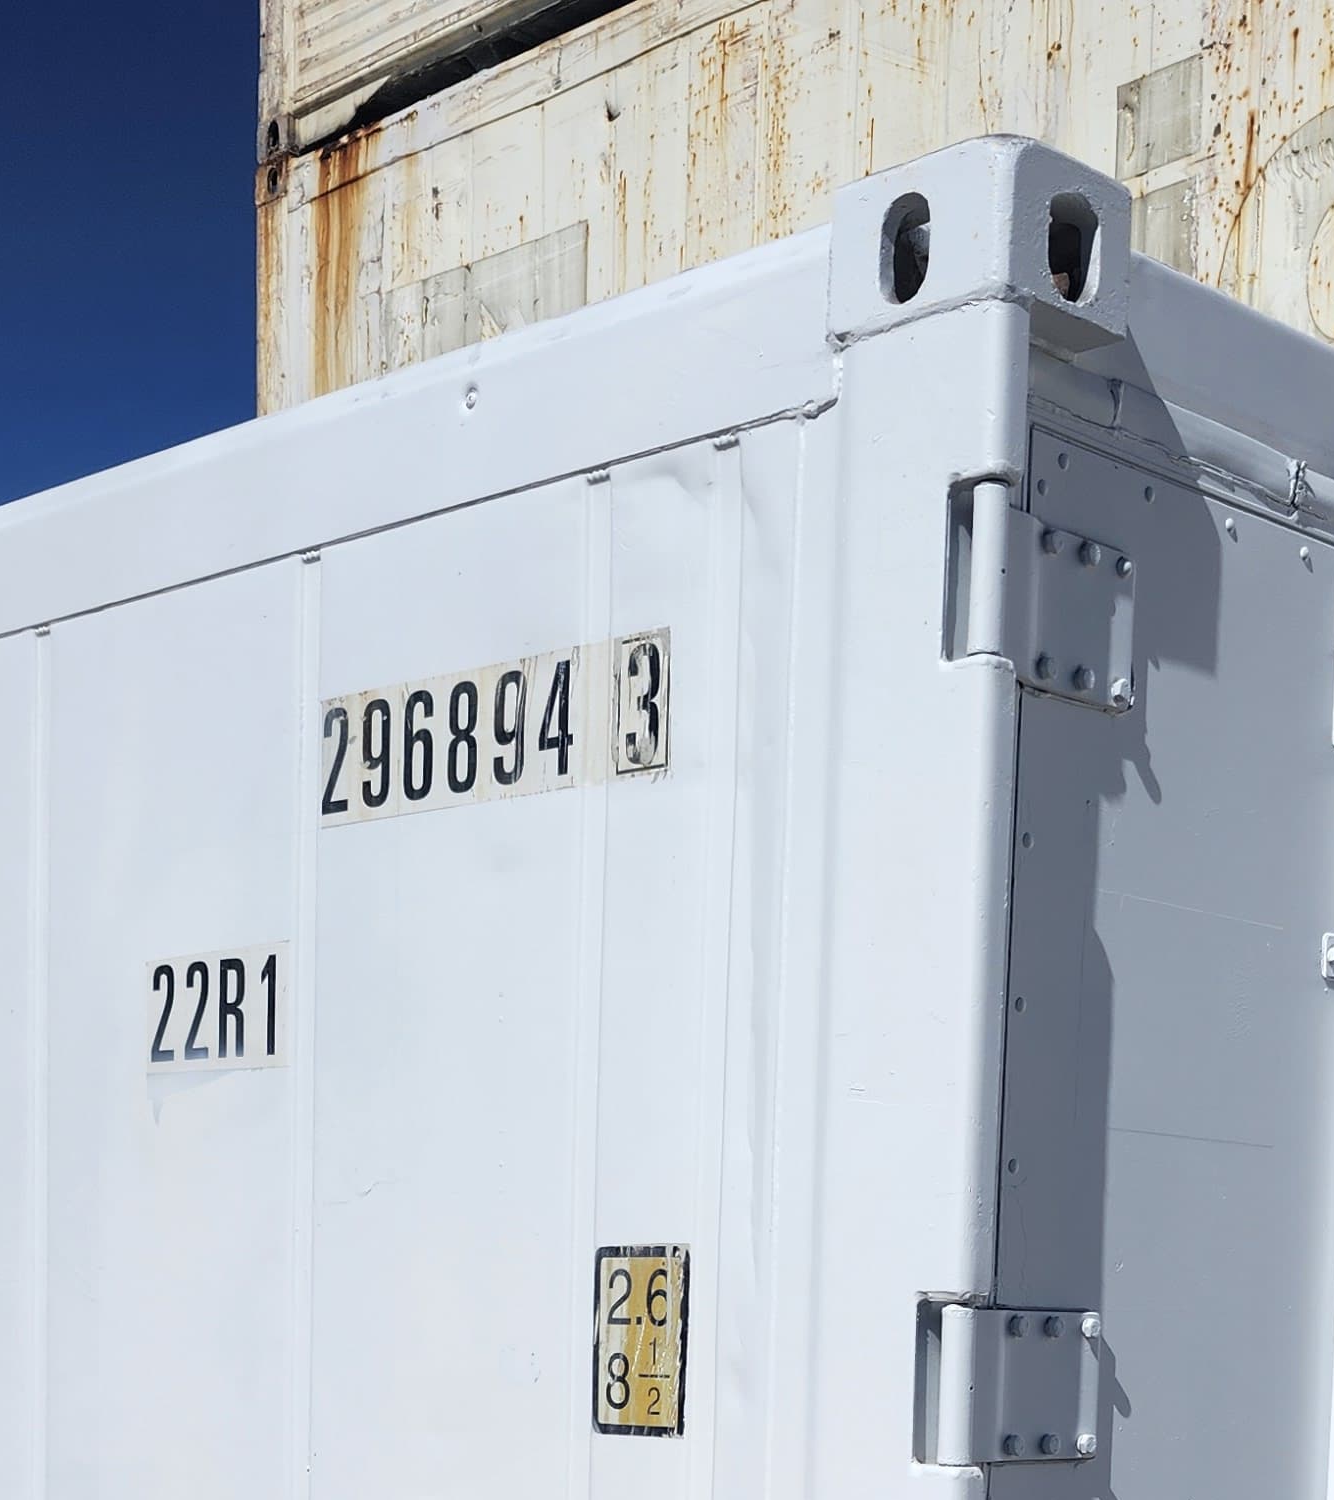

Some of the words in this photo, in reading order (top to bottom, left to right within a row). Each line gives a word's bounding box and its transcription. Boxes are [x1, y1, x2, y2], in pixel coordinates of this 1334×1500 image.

[321, 659, 574, 816] 296894
[625, 643, 661, 766] 3
[150, 954, 278, 1063] 22R1
[607, 1268, 668, 1327] 2.6
[605, 1352, 630, 1410] 8
